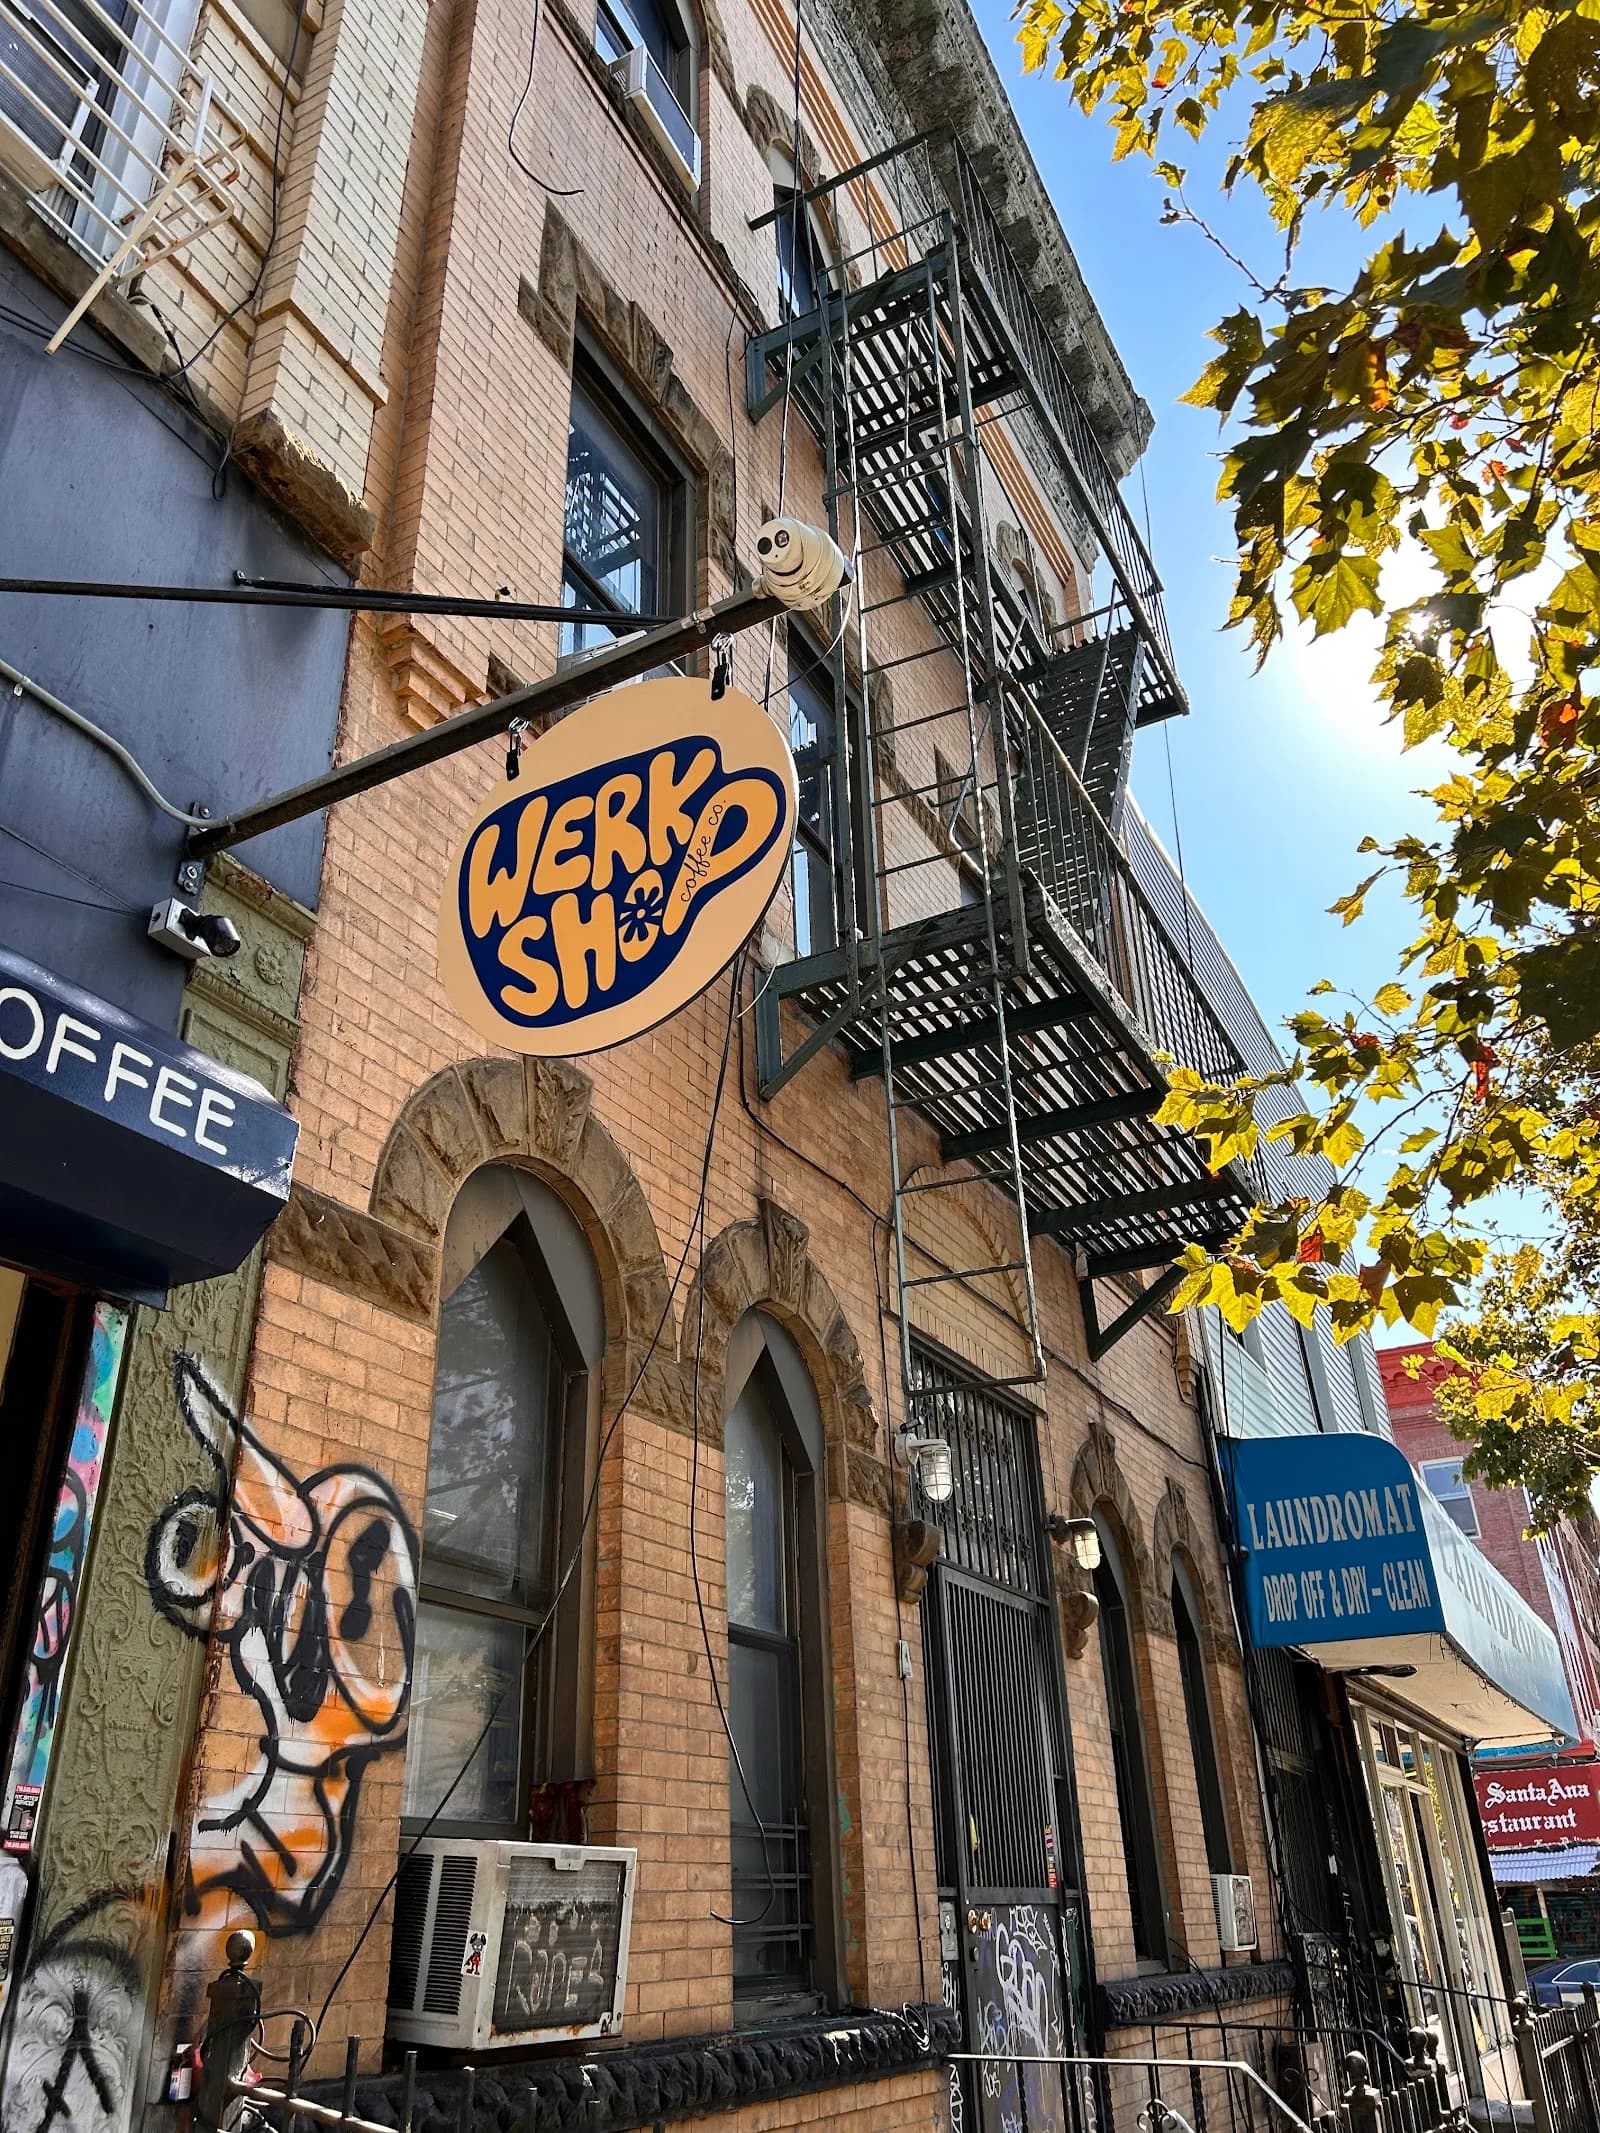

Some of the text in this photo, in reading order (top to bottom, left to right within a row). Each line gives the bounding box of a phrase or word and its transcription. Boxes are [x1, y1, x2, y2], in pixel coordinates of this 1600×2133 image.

[469, 748, 717, 938] WERK
[681, 836, 711, 902] coffee
[498, 779, 778, 1017] SHOP
[1247, 1483, 1417, 1550] LAUNDROMAT
[1262, 1573, 1298, 1623] DROP
[1301, 1570, 1327, 1620] OFF
[1329, 1568, 1343, 1618] &
[1485, 1778, 1590, 1808] Santa Ana
